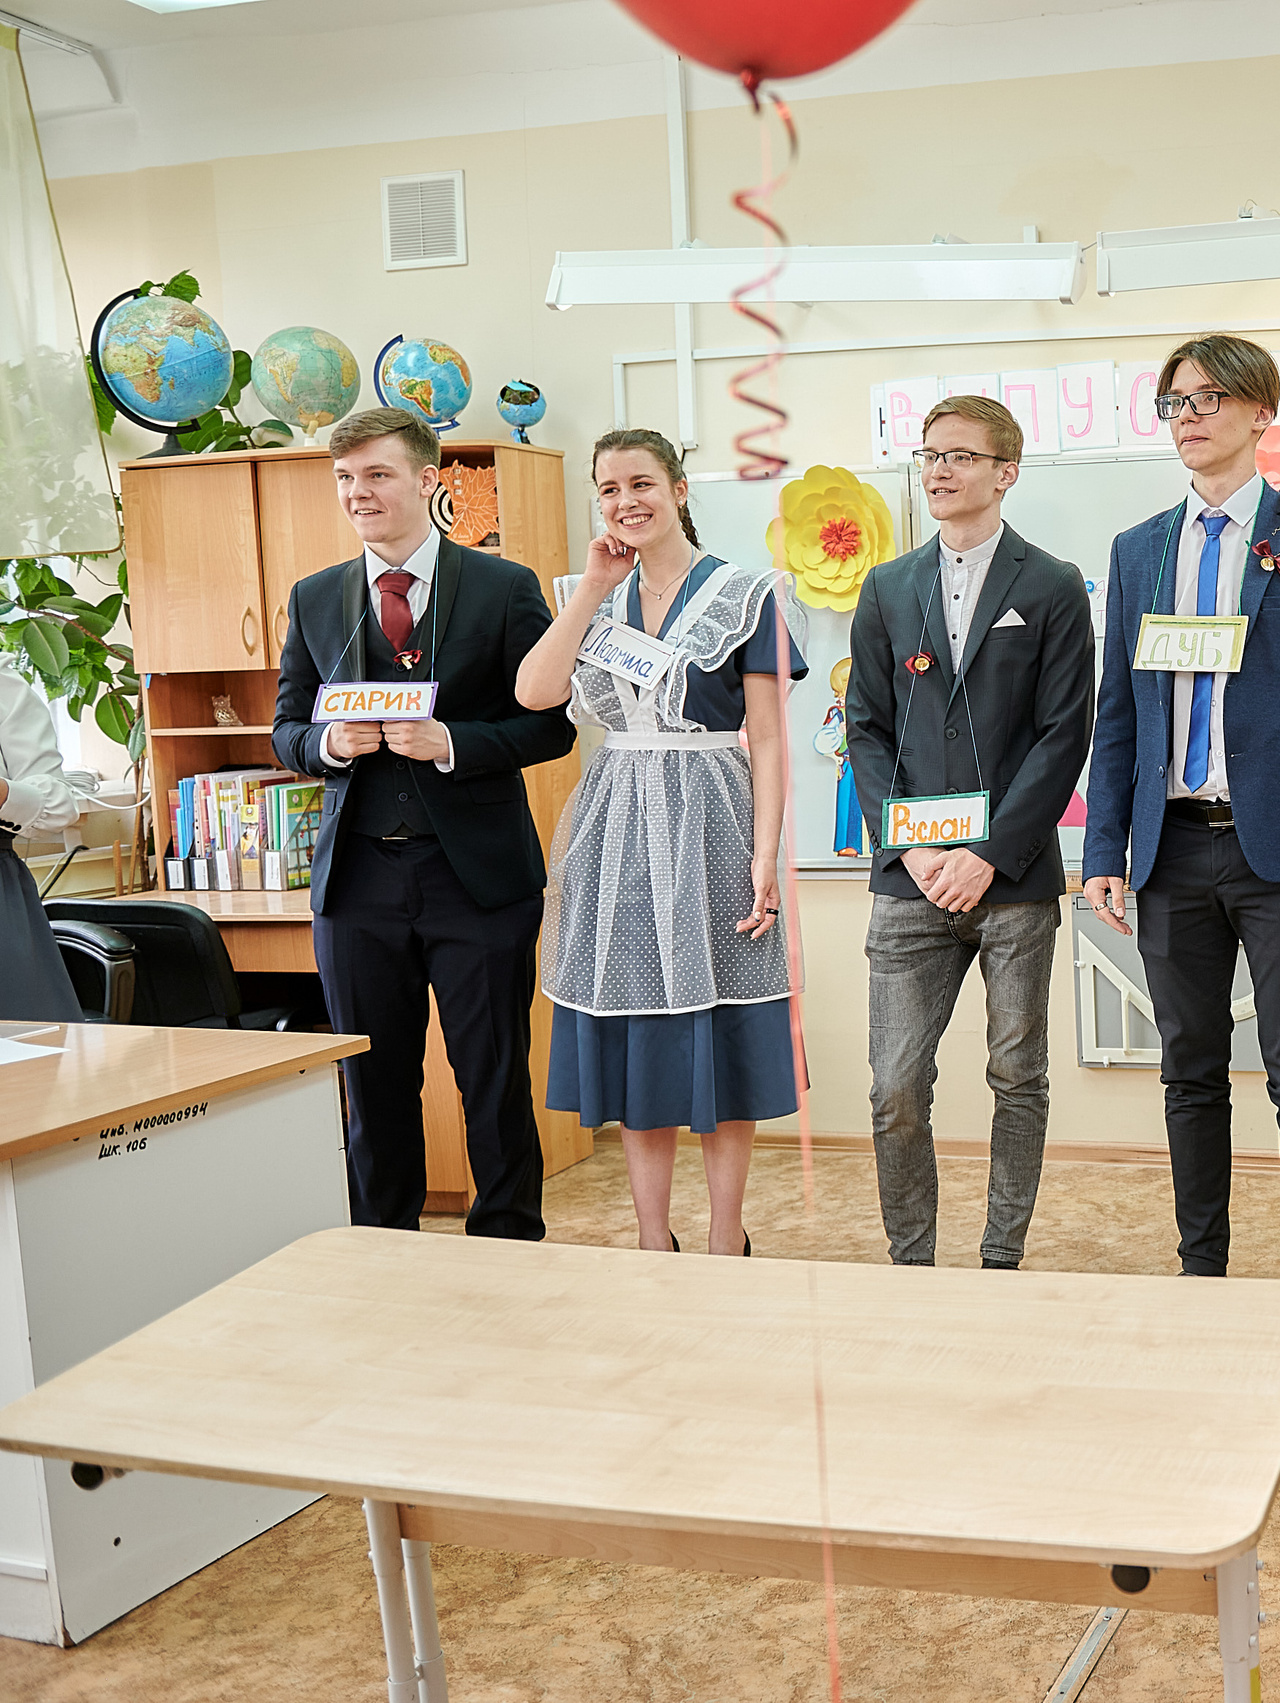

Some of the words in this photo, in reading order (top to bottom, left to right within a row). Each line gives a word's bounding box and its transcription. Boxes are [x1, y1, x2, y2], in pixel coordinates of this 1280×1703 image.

[584, 625, 654, 678] Людмила
[1141, 631, 1223, 669] ДУБ
[324, 690, 422, 713] СТАРИК
[892, 804, 972, 846] Руслан
